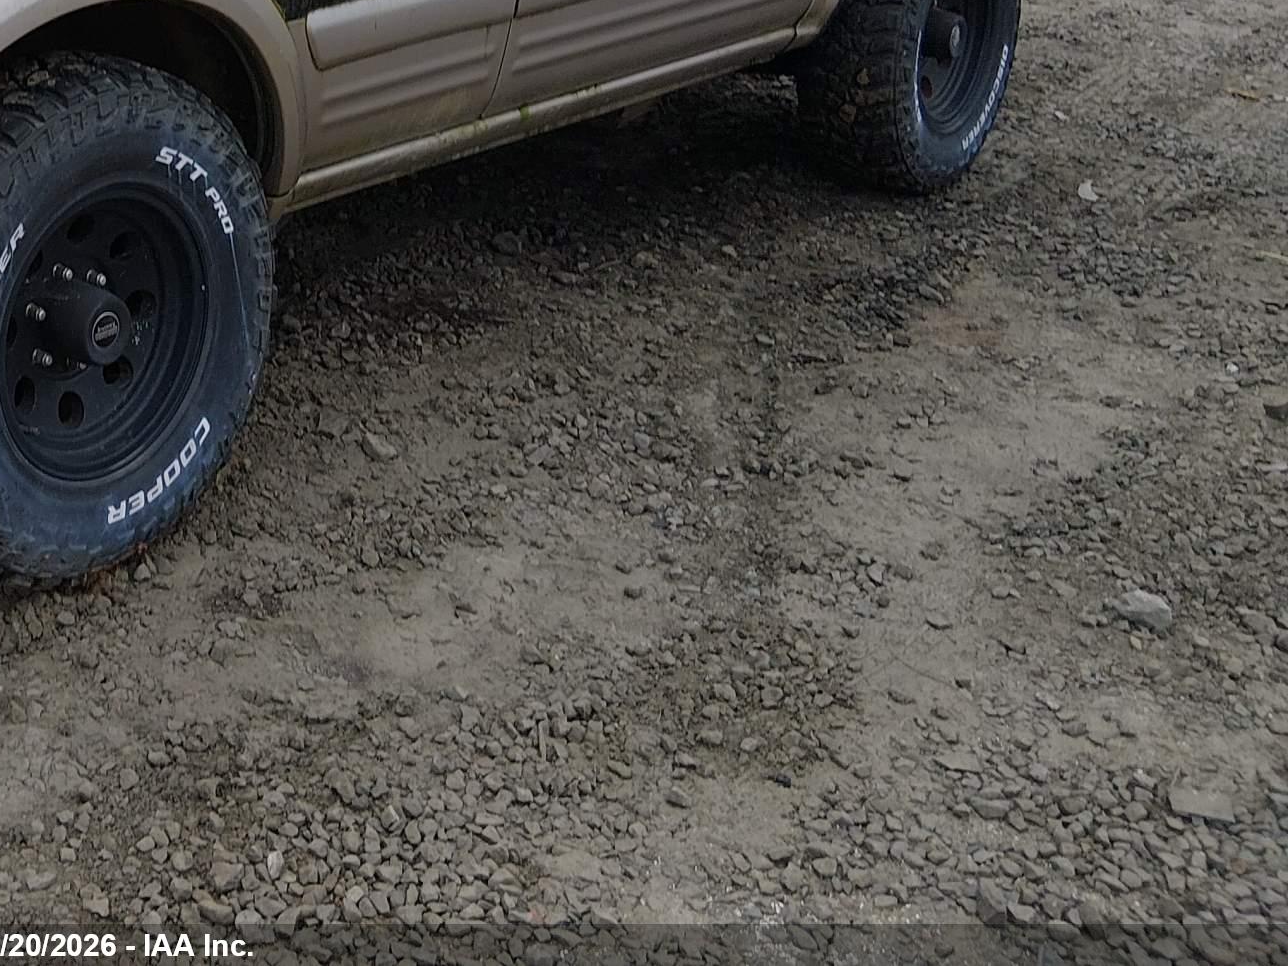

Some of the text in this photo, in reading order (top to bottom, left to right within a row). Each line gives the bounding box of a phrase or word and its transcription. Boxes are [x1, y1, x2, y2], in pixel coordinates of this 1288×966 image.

[961, 43, 1010, 151] DISCOVERER
[155, 146, 234, 234] STT PRO
[107, 416, 211, 524] COOPER
